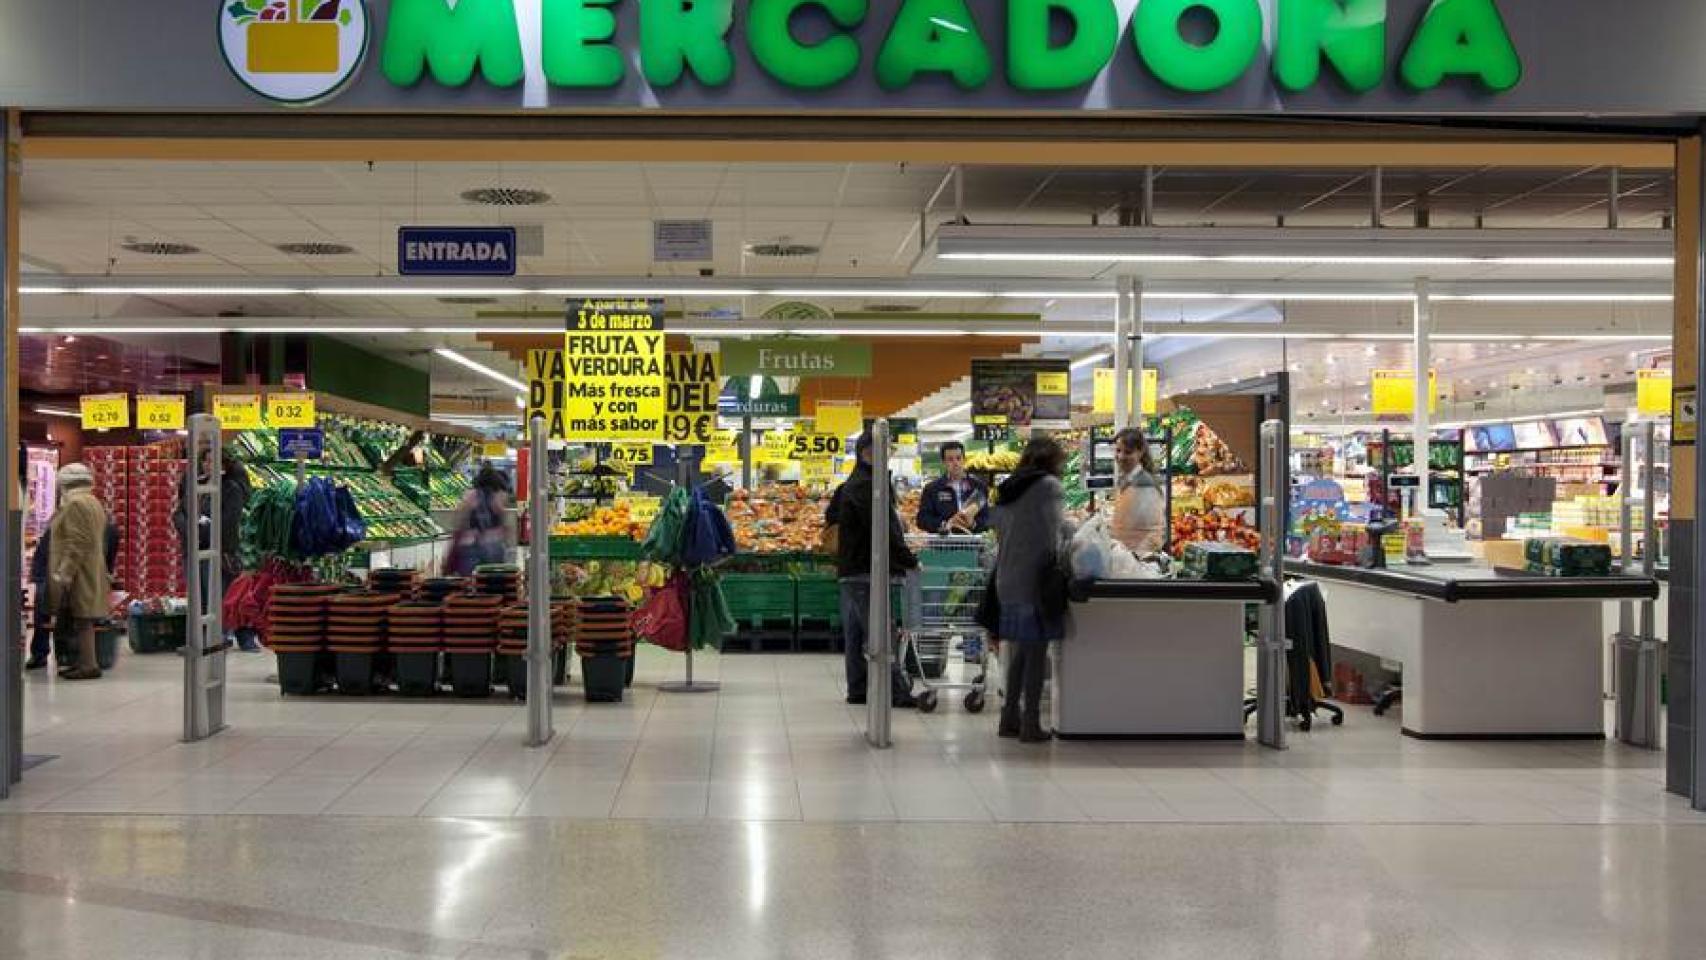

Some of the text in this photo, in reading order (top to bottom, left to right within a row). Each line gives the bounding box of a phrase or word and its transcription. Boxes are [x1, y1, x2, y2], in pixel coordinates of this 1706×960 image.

[380, 0, 1523, 92] MERCADONA
[405, 242, 506, 261] ENTRADA
[577, 311, 653, 329] 3 de marzo
[569, 335, 660, 354] FRUTA Y
[569, 358, 661, 376] VERDURA
[758, 348, 835, 369] Frutas
[568, 382, 661, 398] Más fresca
[667, 383, 717, 412] DEL
[593, 402, 638, 415] y con
[571, 416, 659, 431] más sabor
[795, 435, 839, 458] 5,50
